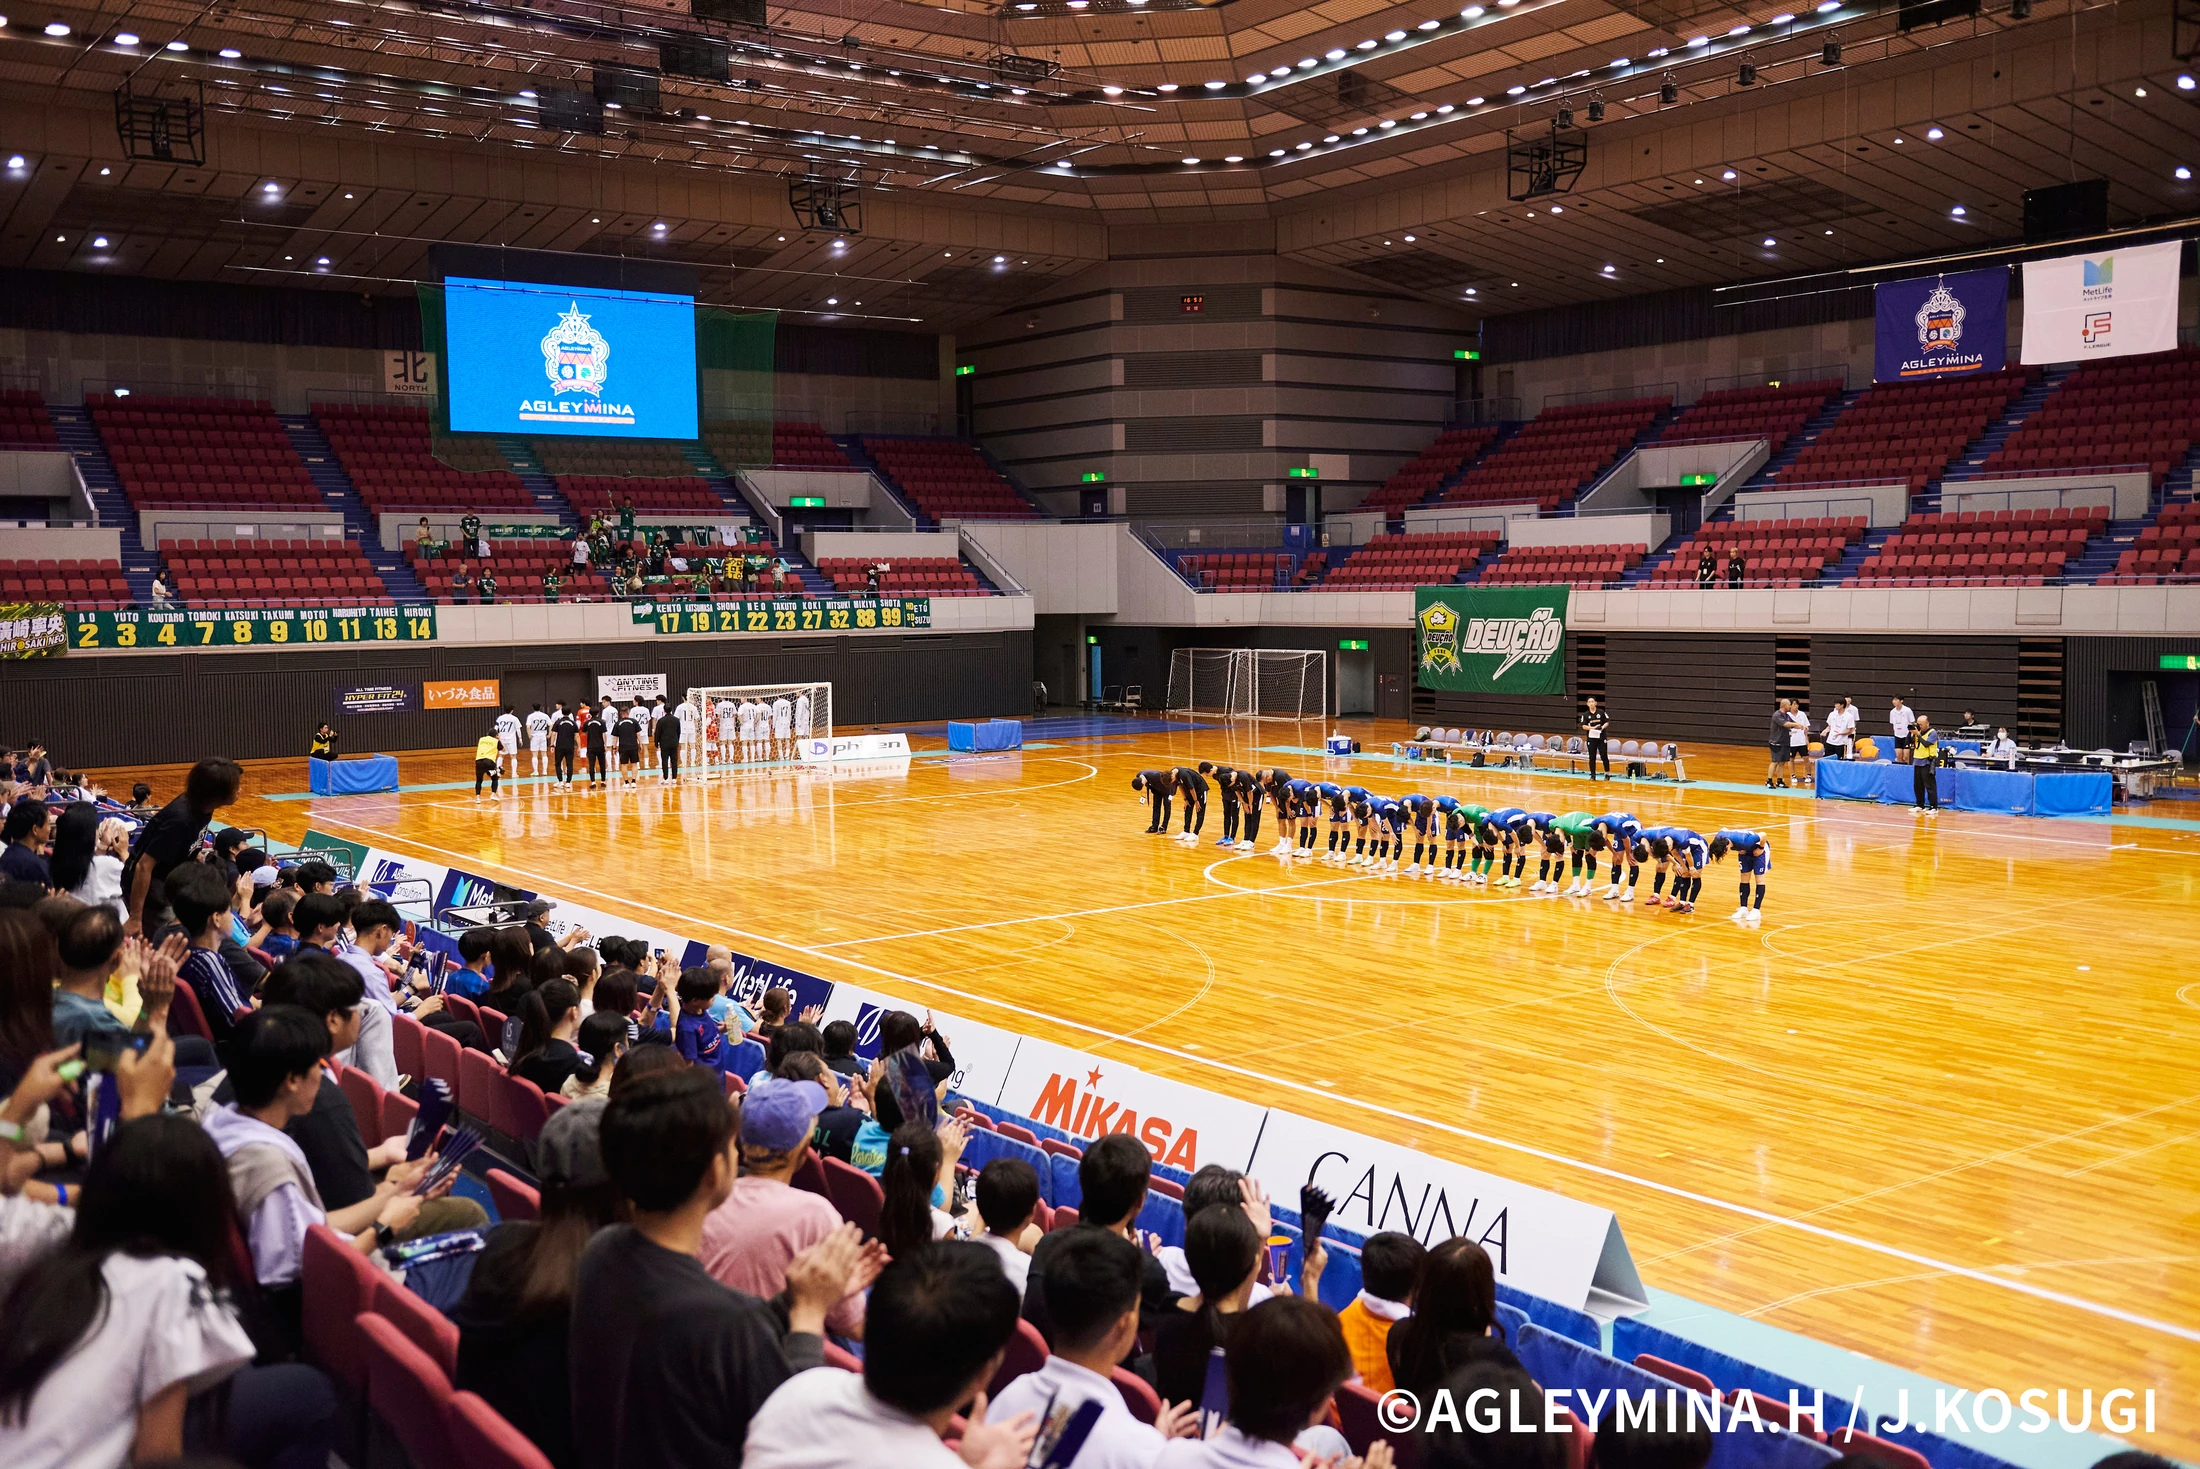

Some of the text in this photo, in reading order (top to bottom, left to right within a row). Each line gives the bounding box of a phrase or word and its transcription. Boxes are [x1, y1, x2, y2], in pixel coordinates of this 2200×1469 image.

[2082, 287, 2112, 296] MetLife
[393, 351, 428, 383] 北
[1901, 353, 1983, 370] AGLEYMINA
[394, 384, 428, 392] NORTH
[519, 399, 635, 415] AGLEYMINA
[656, 604, 682, 612] KENTO
[716, 602, 740, 611] SHOMA
[772, 602, 797, 610] TAKUTO
[802, 601, 821, 610] KOKI
[880, 599, 900, 608] SHOTA
[114, 612, 139, 622] YUTO
[148, 613, 184, 622] KOUTARO
[188, 611, 221, 621] TOMOKI
[224, 610, 259, 620] KATSUKI
[262, 610, 294, 620] TAKUMI
[300, 610, 328, 620] MOTOI
[370, 608, 398, 617] TAIHEI
[404, 608, 432, 617] HIROKI
[660, 608, 902, 633] 17 19 21 22 23 27 32 88 99
[78, 618, 431, 647] 2 3 4 7 8 9 10 11 13 14
[48, 634, 65, 646] NEO
[616, 677, 659, 686] ANYTIME
[617, 684, 659, 692] FITNESS
[428, 687, 496, 701] いづみ食品
[500, 720, 514, 732] 27
[533, 720, 548, 731] 22
